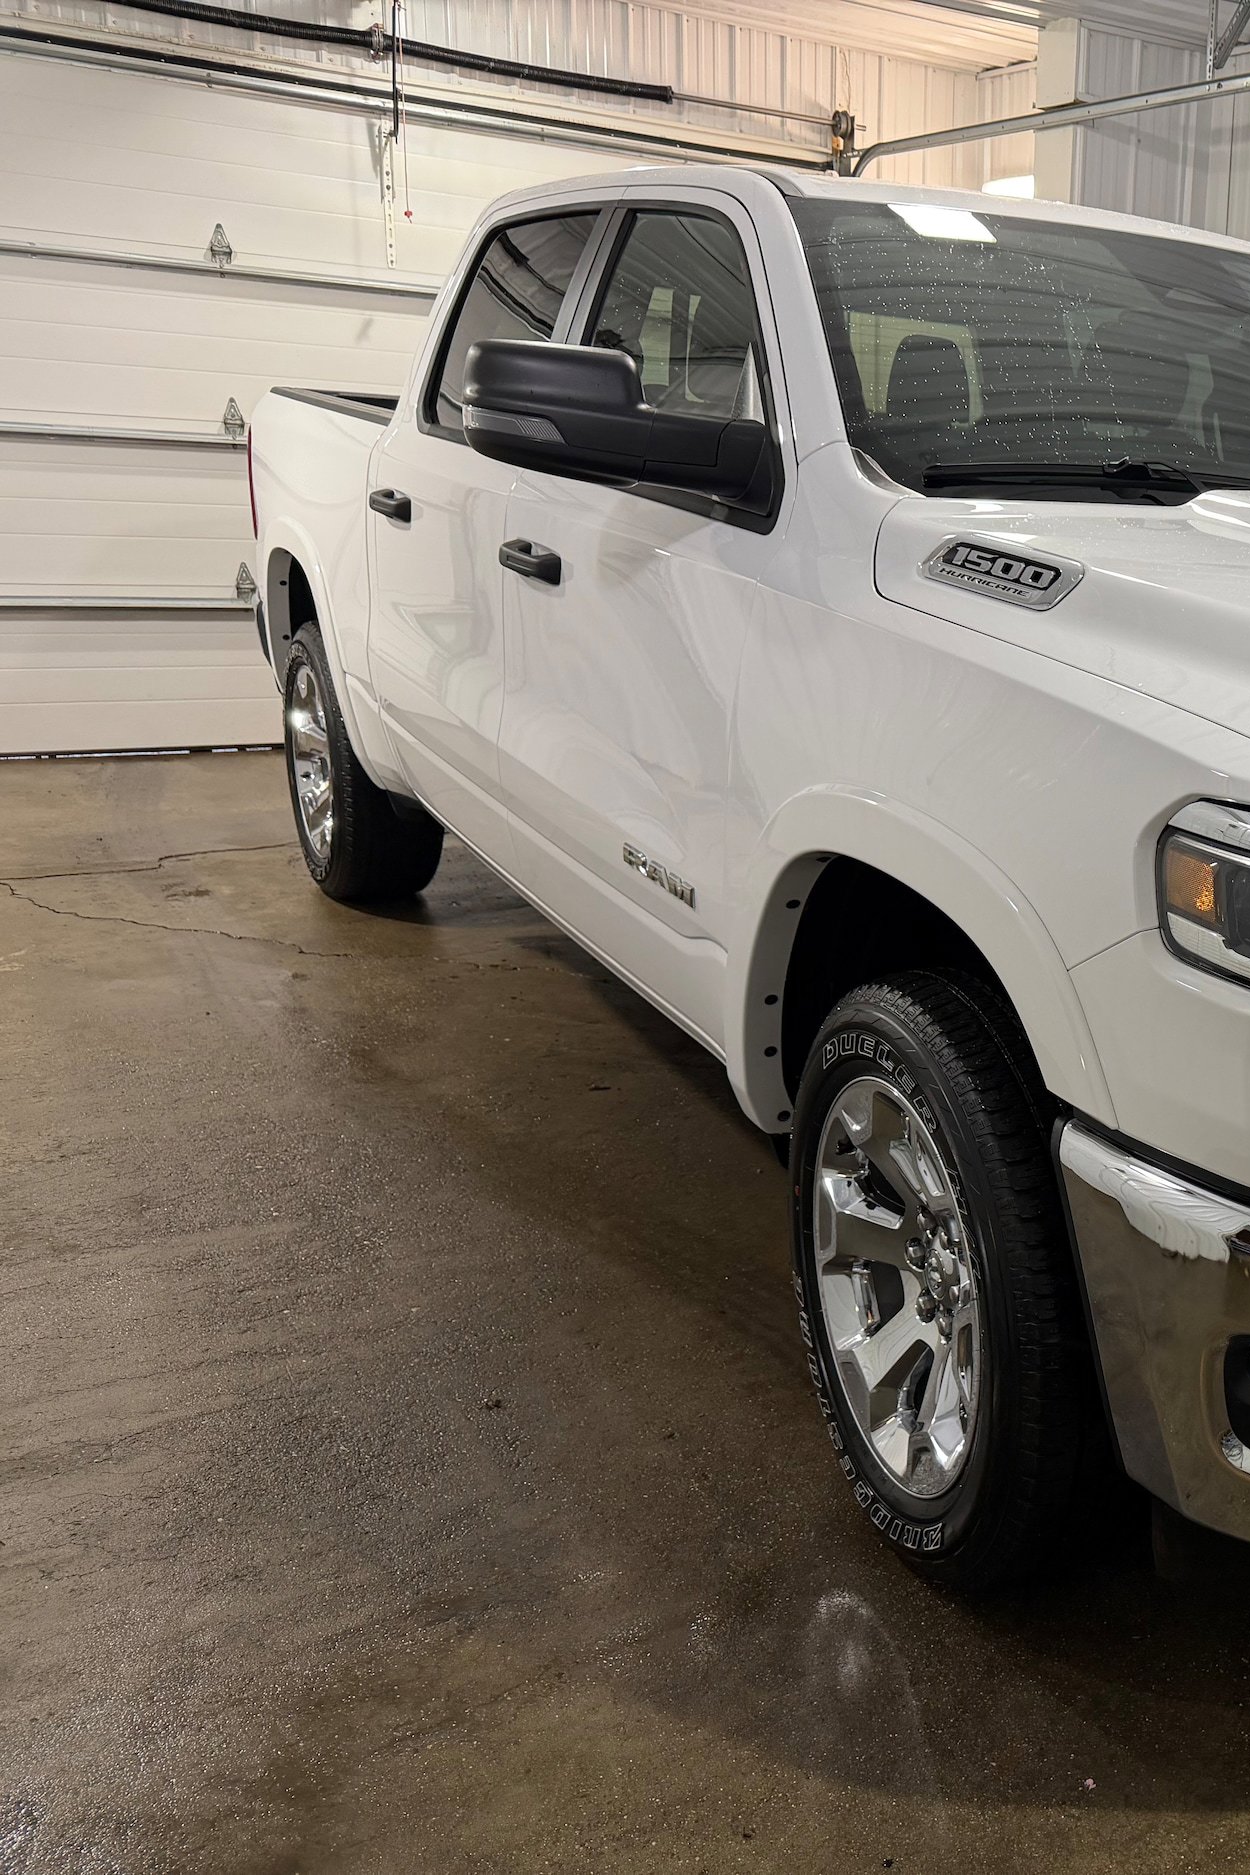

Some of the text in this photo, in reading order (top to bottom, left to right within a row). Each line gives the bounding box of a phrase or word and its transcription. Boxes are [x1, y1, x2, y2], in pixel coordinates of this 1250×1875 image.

[938, 567, 1031, 597] HURRICANE
[951, 546, 1057, 589] 1500
[623, 842, 696, 911] RAM
[821, 1032, 939, 1135] DUELER
